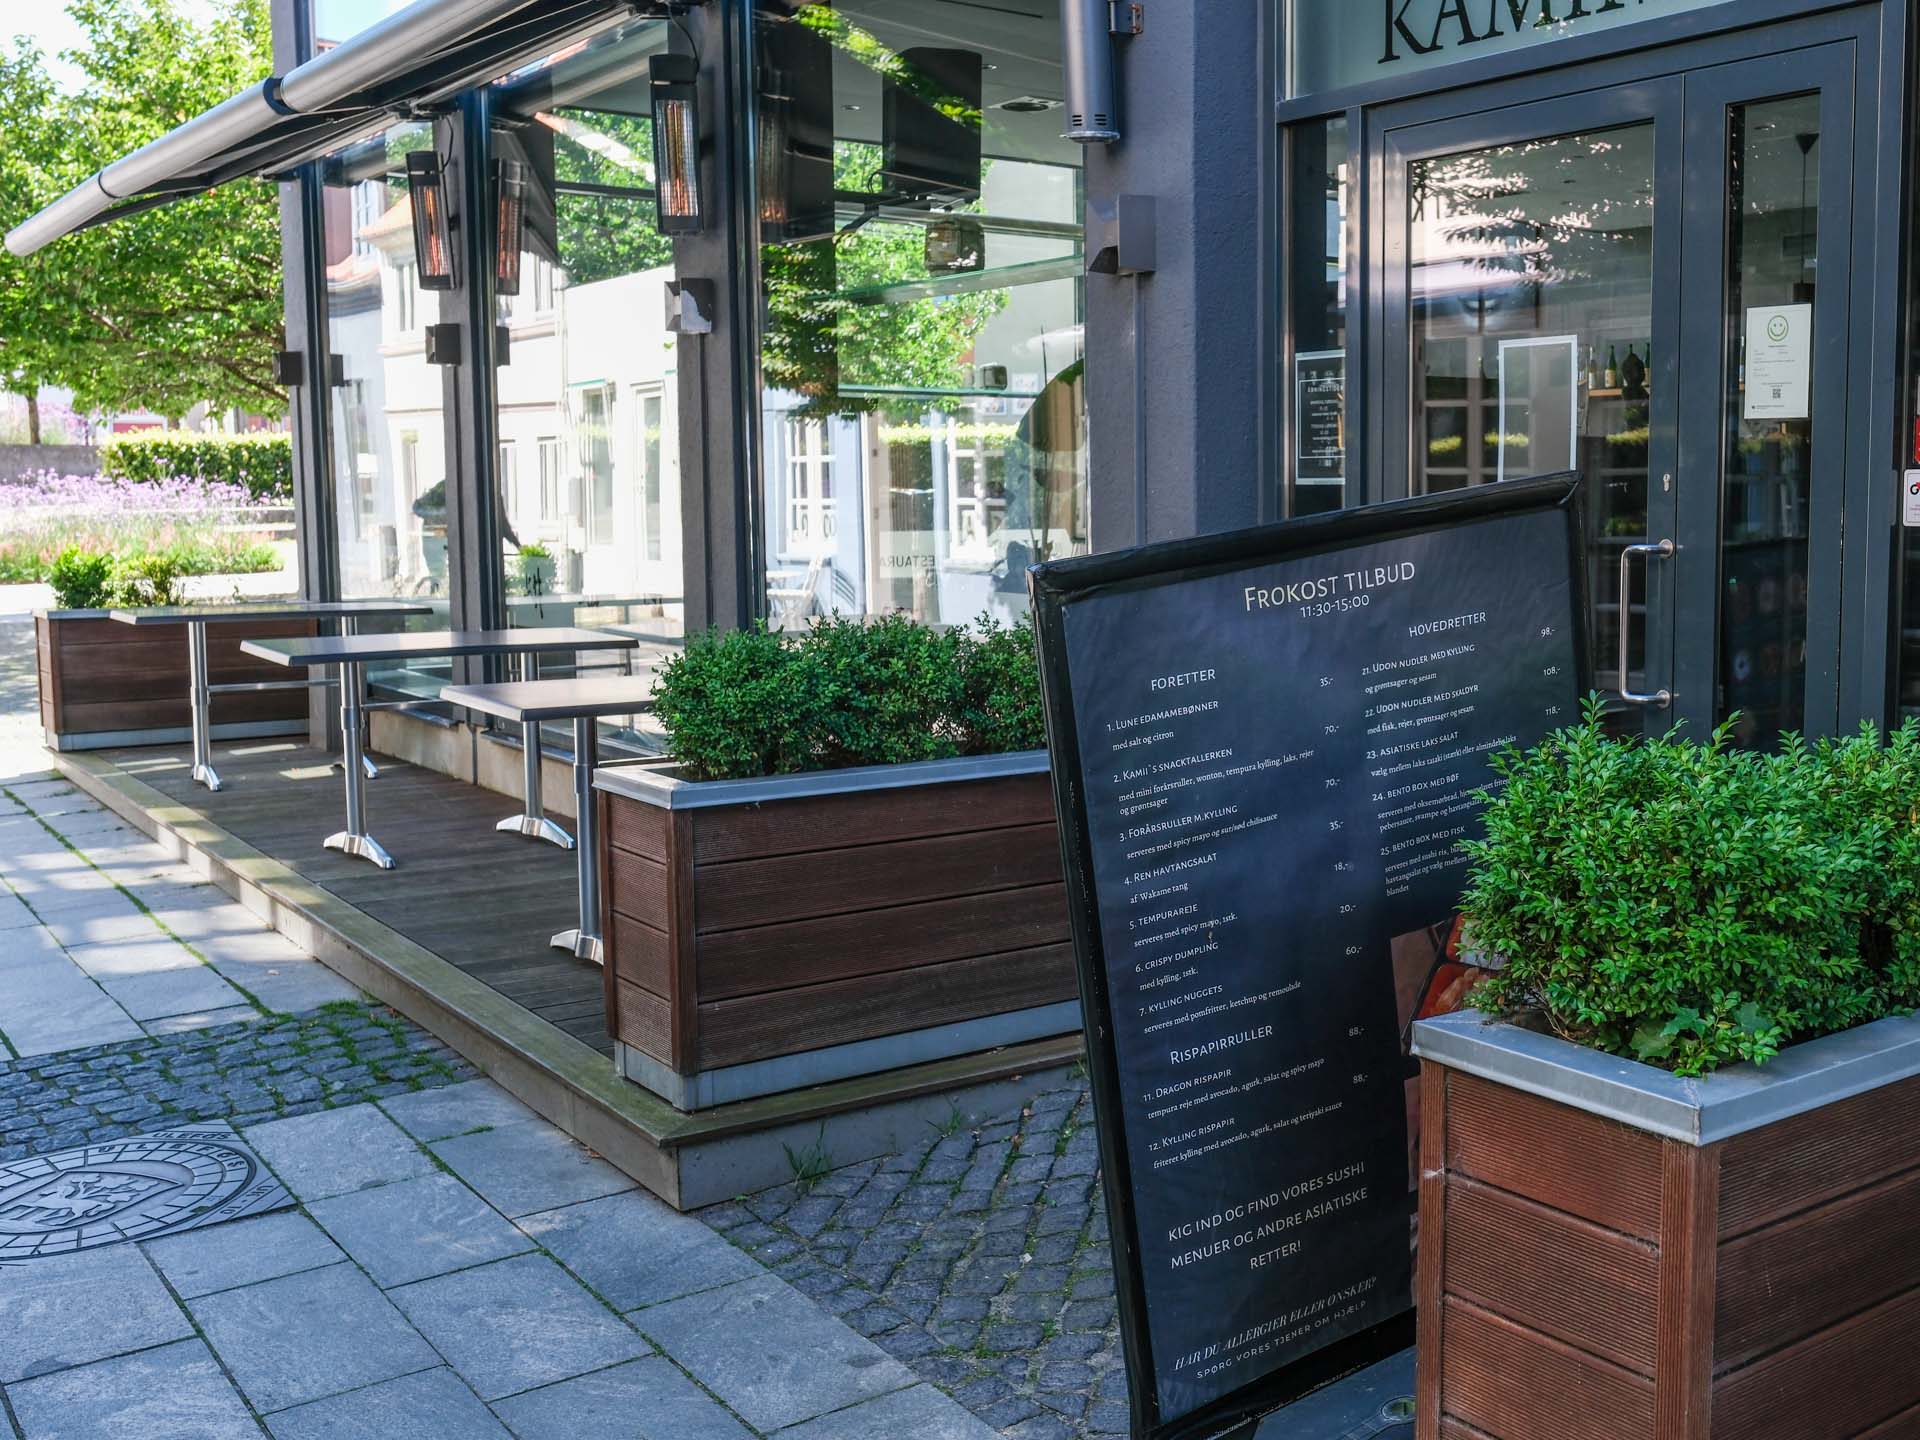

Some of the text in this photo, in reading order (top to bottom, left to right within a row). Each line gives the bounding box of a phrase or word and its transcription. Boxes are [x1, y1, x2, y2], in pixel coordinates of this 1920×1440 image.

[1244, 562, 1415, 611] FROKOST TILBUD
[1300, 594, 1370, 618] 11:30-15:00
[1408, 612, 1486, 637] HOVEDRETTER
[1361, 644, 1475, 676] 21. UDON NUDLER MED KYLLING
[1151, 668, 1216, 691] FORETTER
[1364, 686, 1374, 695] og
[1106, 700, 1219, 732] 1. LUNE EDAMAMEBØNNER
[1364, 708, 1376, 718] 22.
[1376, 702, 1400, 714] UDON
[1401, 696, 1433, 709] NUDLER
[1433, 692, 1451, 702] MED
[1112, 731, 1174, 751] med salt og citron
[1366, 731, 1458, 760] 23. ASIATISKE LAKS SALAT
[1113, 774, 1122, 783] 2.
[1158, 748, 1233, 772] SNACKTALLERKEN
[1371, 772, 1460, 802] 24. BENTO BOX MED BØF
[1119, 797, 1168, 817] og grøntsager
[1119, 805, 1238, 842] 3. FORÅRSRULLER M.KYLLING
[1126, 846, 1156, 860] serveres
[1156, 840, 1173, 852] med
[1173, 837, 1192, 849] spicy
[1191, 832, 1211, 842] mayo
[1210, 829, 1220, 838] og
[1380, 825, 1466, 856] 25. BENTO BOX MED FISK
[1124, 852, 1217, 886] 4. REN HAVTANGSALAT
[1130, 882, 1189, 904] af Wakame tang
[1129, 903, 1198, 930] 5. TEMPURAREJE
[1135, 940, 1219, 973] 6. CRISPY DUMPLING
[1138, 984, 1223, 1017] 7. KYLLING NUGGETS
[1170, 1025, 1273, 1064] RISPAPIRRULLER
[1143, 1069, 1232, 1102] 11. DRAGON RISPAPIR
[1148, 1117, 1235, 1152] 12. KYLLING RISPAPIR
[1168, 1161, 1365, 1241] KIG IND OG FIND VORES SUSHI
[1171, 1187, 1368, 1269] MENUER OG ANDRE ASIATISKE
[1250, 1240, 1301, 1269] RETTER!
[1196, 1300, 1366, 1379] SPØRG VORES TJENER OM HJÆLP
